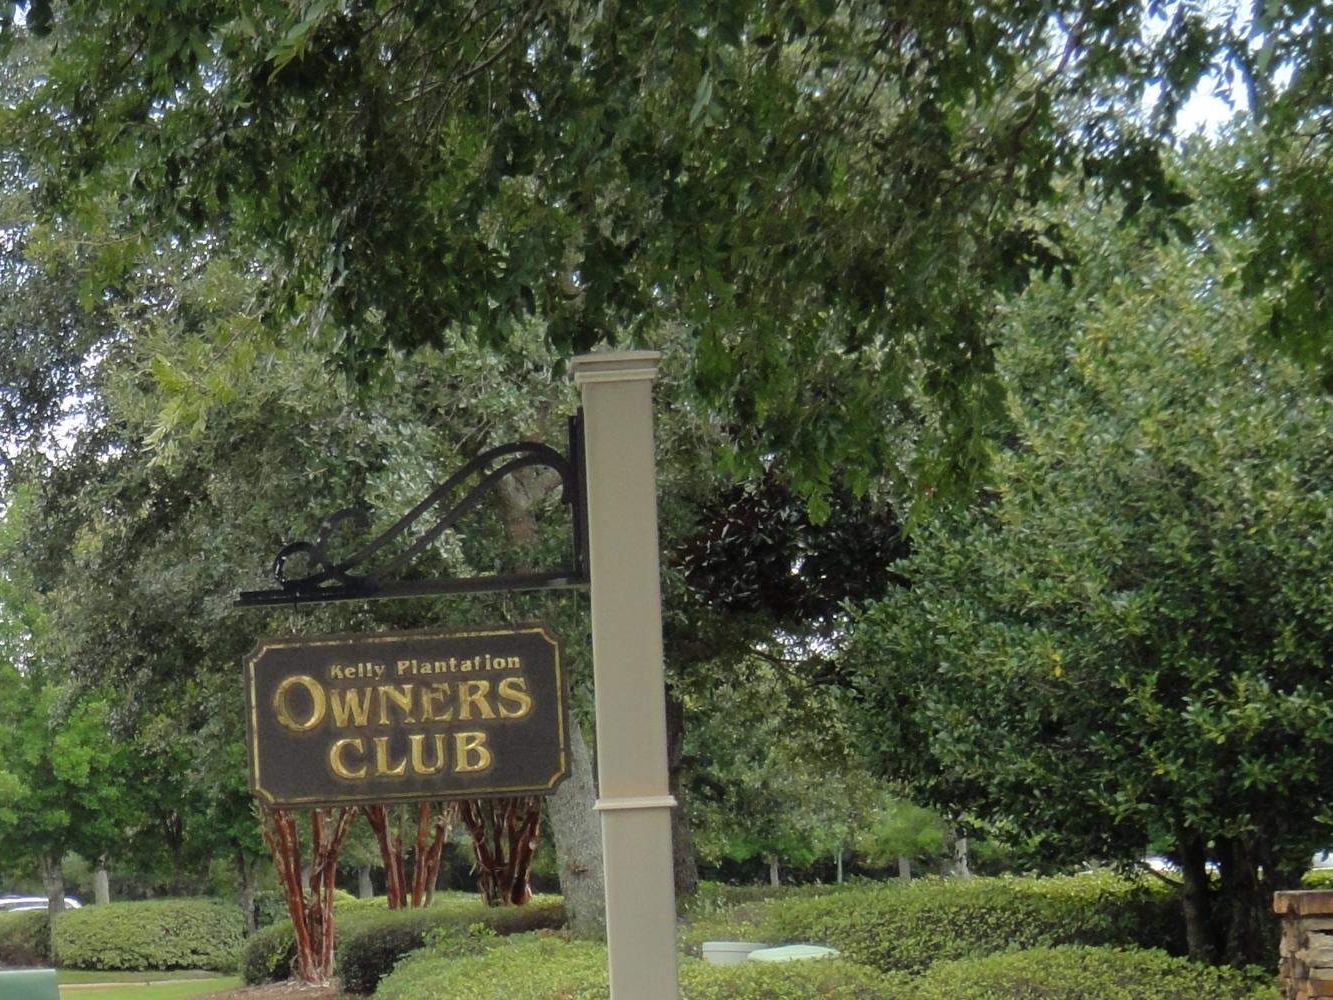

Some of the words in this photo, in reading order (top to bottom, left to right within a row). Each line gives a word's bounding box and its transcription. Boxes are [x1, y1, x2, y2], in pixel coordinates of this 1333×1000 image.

[330, 660, 386, 681] Kelly
[396, 653, 522, 676] Plantation
[273, 675, 533, 732] OWNERS
[329, 731, 493, 779] CLUB
